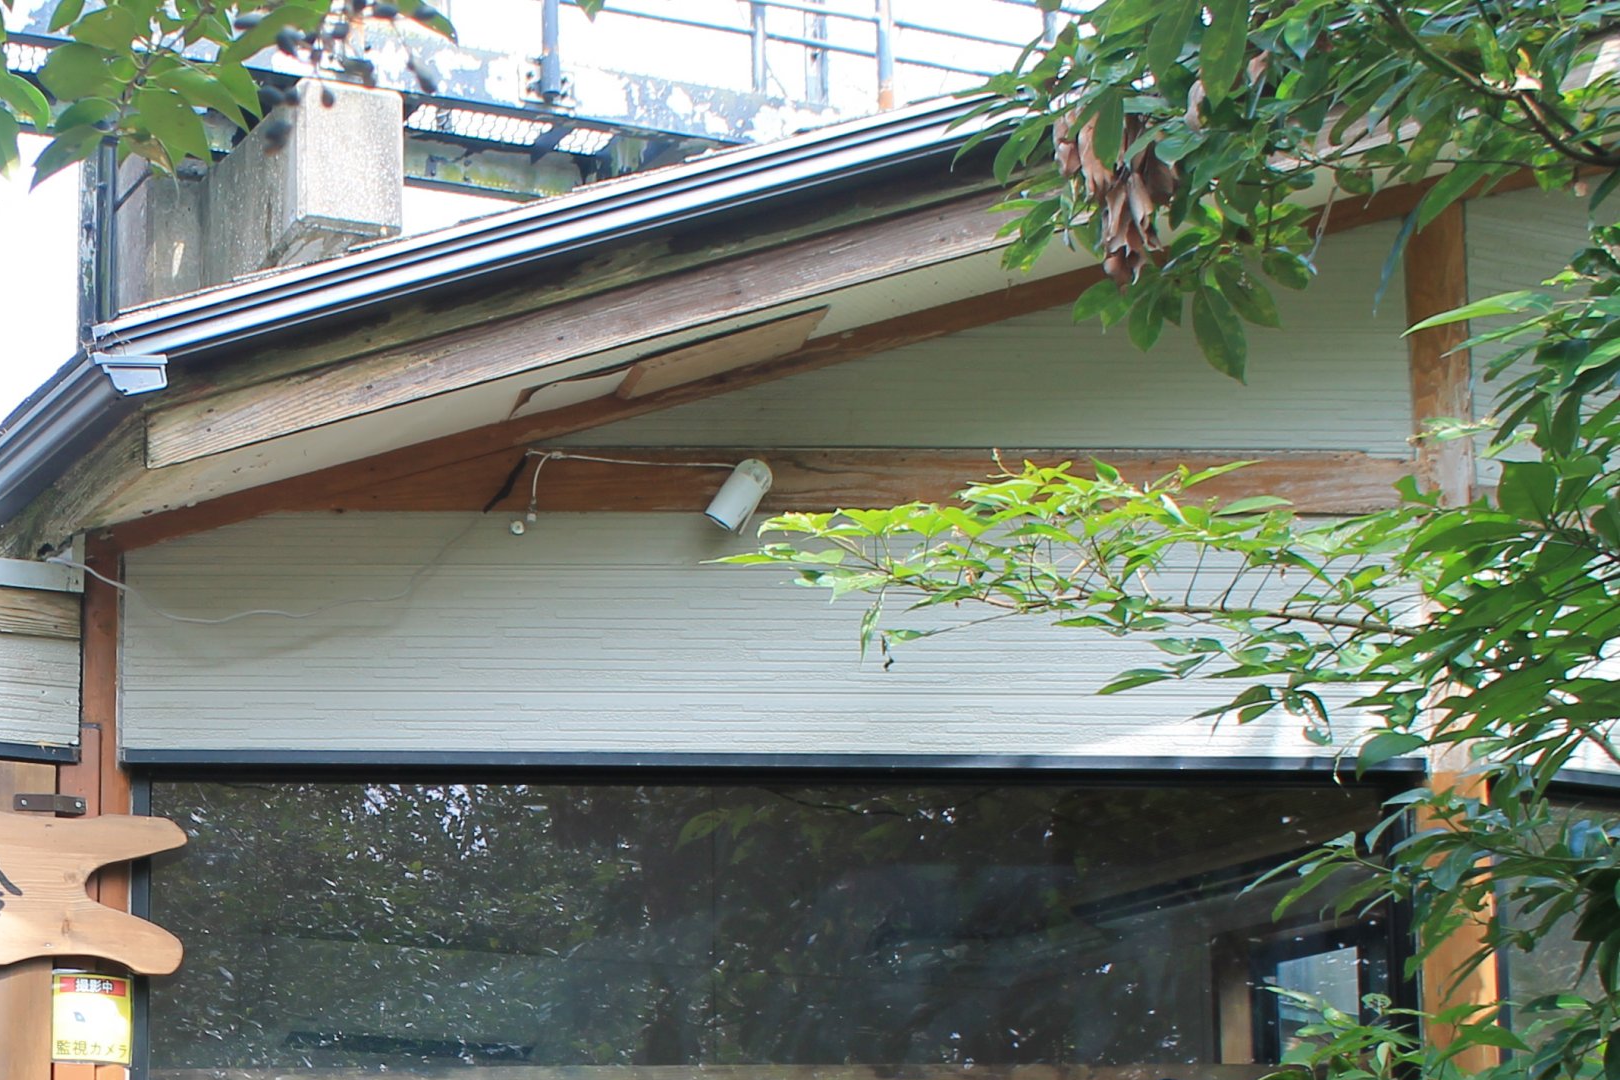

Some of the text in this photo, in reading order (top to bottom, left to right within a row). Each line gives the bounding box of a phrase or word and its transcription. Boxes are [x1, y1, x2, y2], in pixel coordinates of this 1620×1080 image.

[75, 977, 114, 993] 撮影中
[56, 1040, 127, 1058] 監視カメラ
